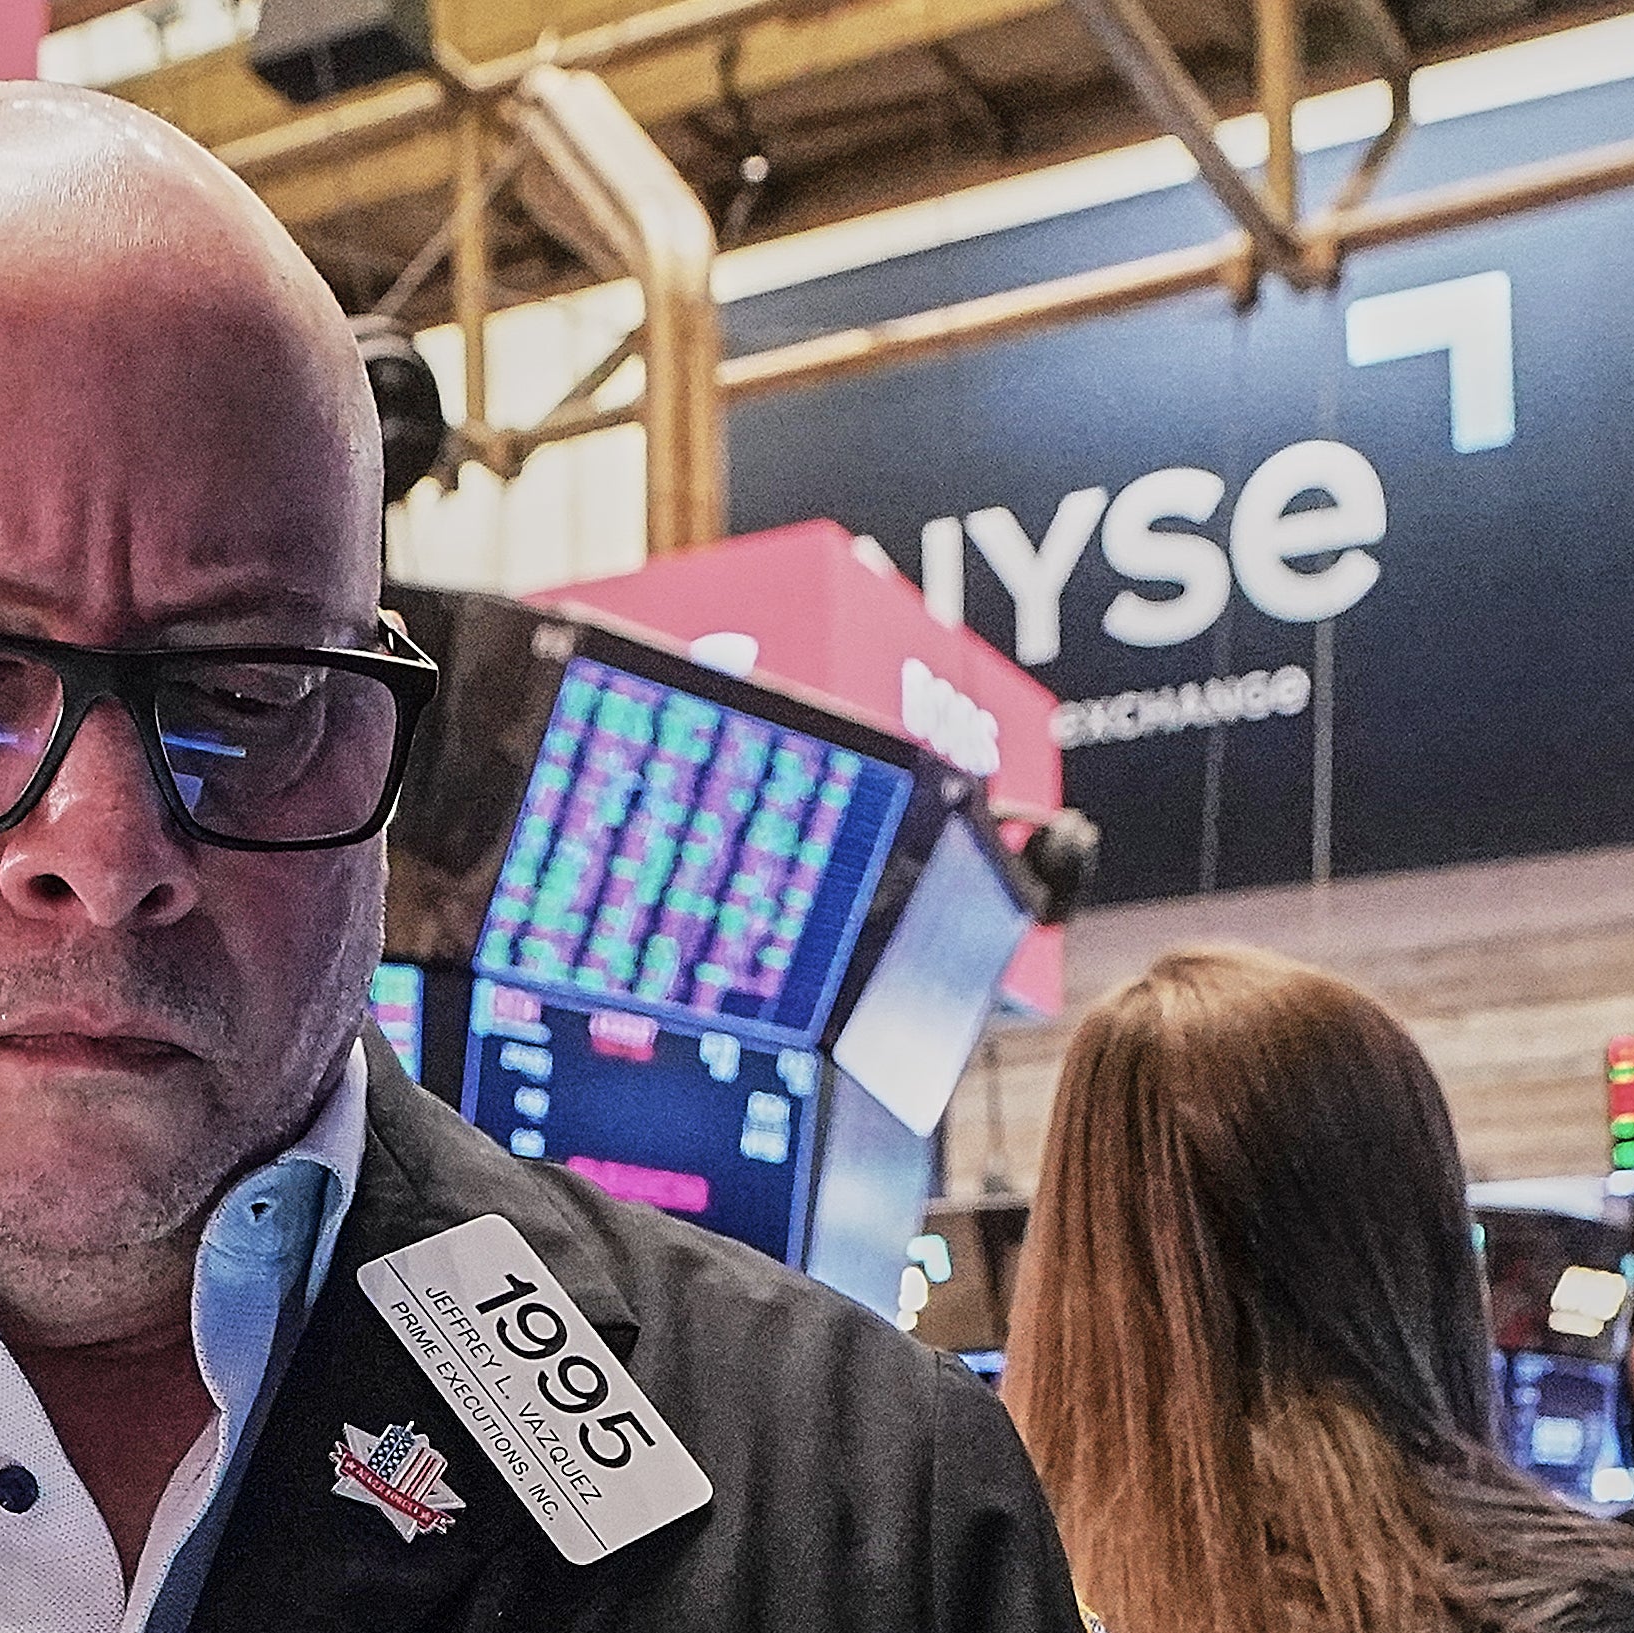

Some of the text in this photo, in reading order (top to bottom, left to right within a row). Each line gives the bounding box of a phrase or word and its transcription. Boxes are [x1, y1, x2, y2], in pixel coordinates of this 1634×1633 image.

[391, 1302, 559, 1521] PRIME EXECUTIONS, INC.
[426, 1287, 602, 1505] JEFFREY L. VAZQUEZ
[476, 1273, 655, 1468] 1995
